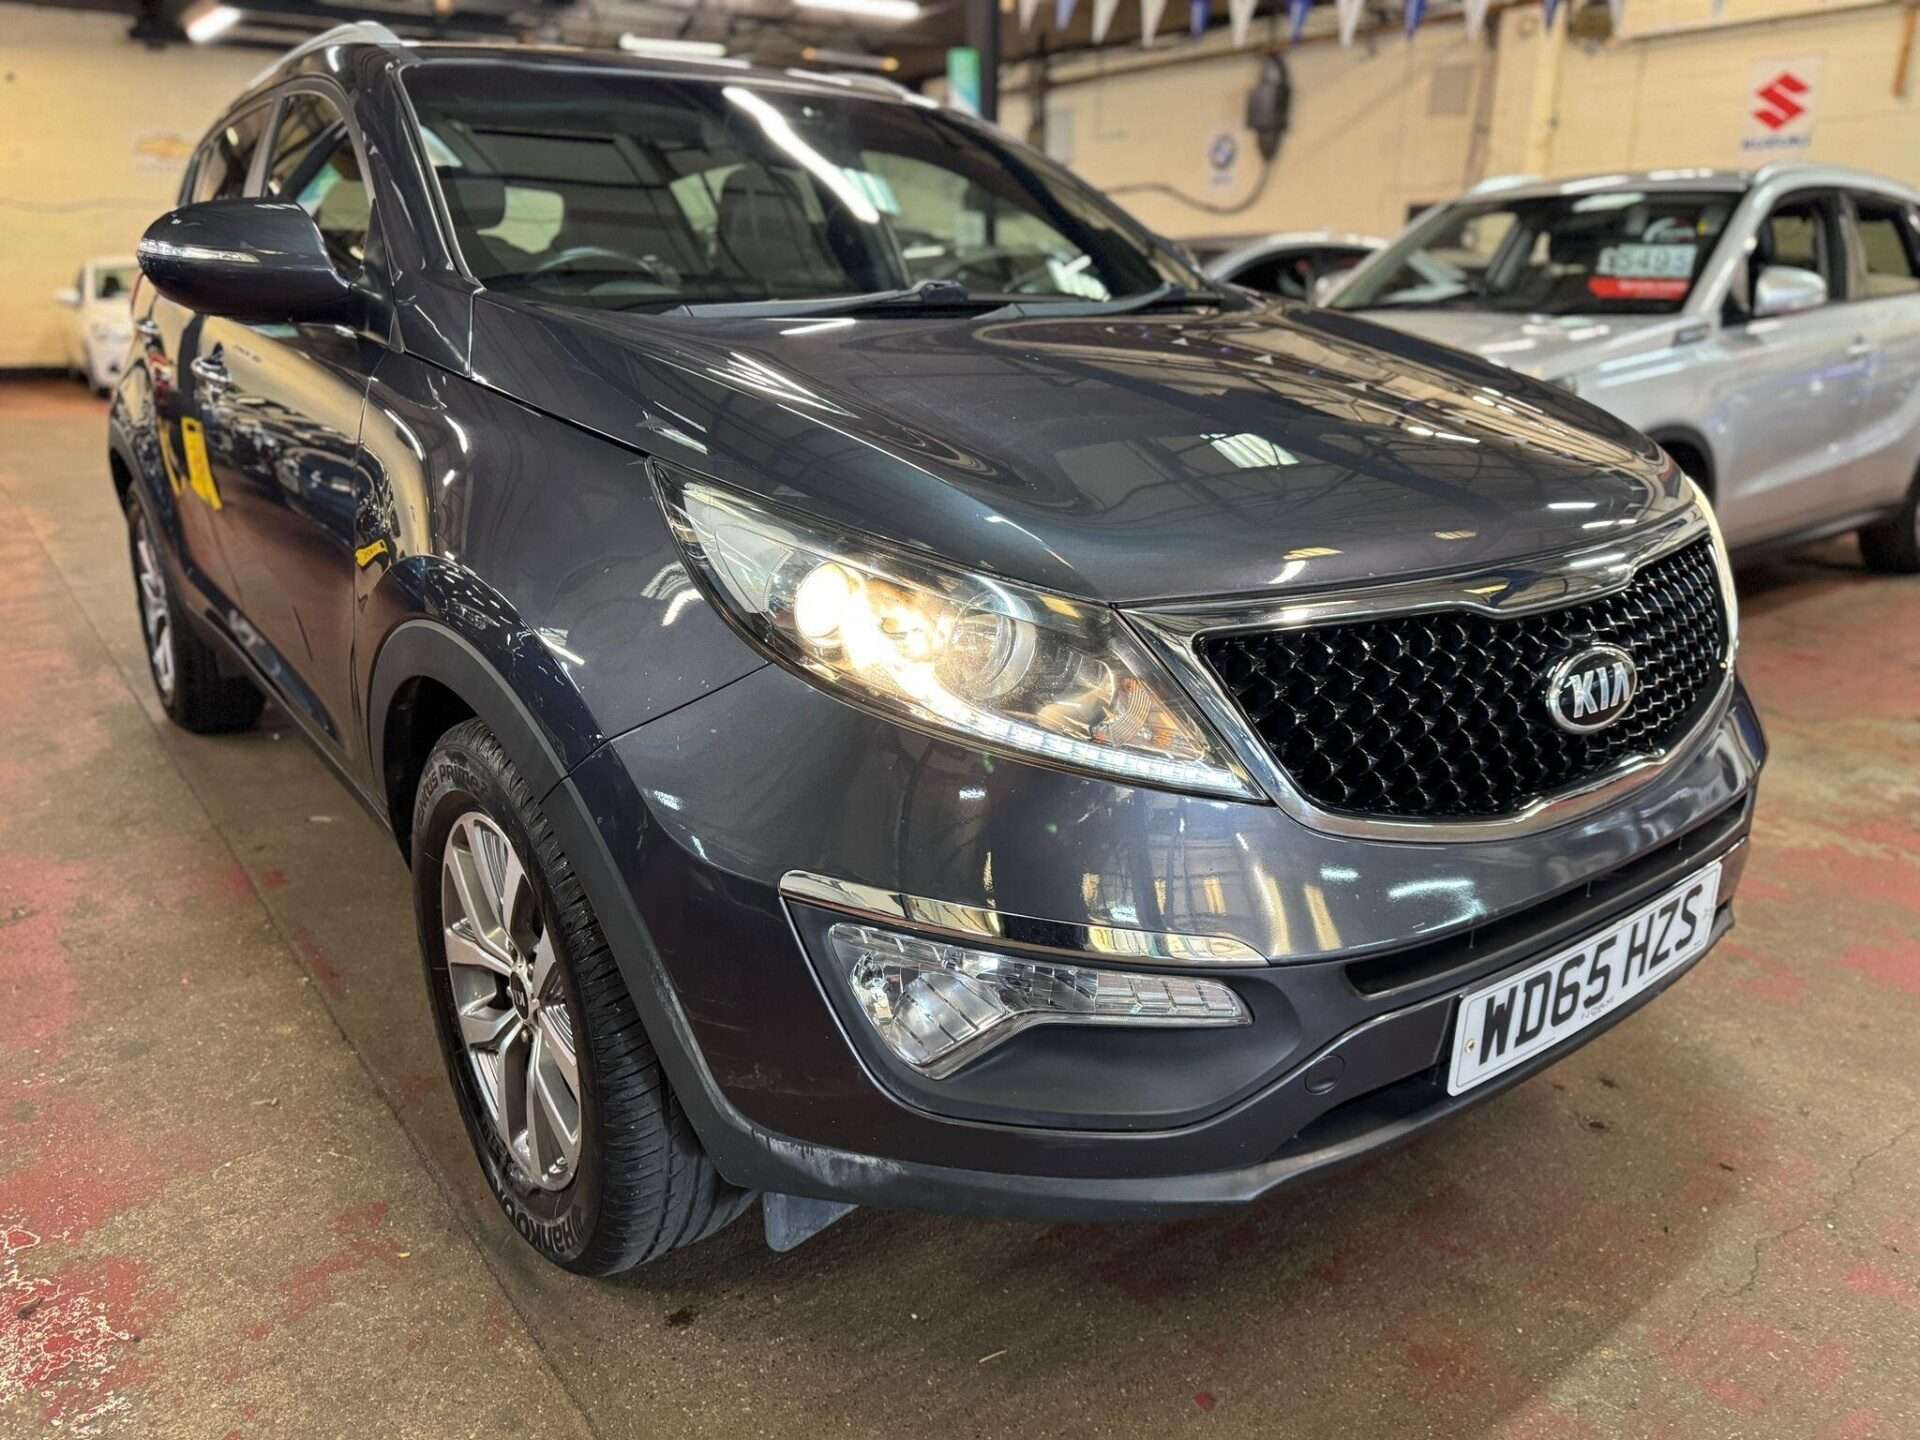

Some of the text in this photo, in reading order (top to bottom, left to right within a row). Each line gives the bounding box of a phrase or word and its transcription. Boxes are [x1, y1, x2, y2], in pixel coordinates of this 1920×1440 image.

[1569, 662, 1630, 718] KIA
[1479, 885, 1703, 1066] WD65 HZS
